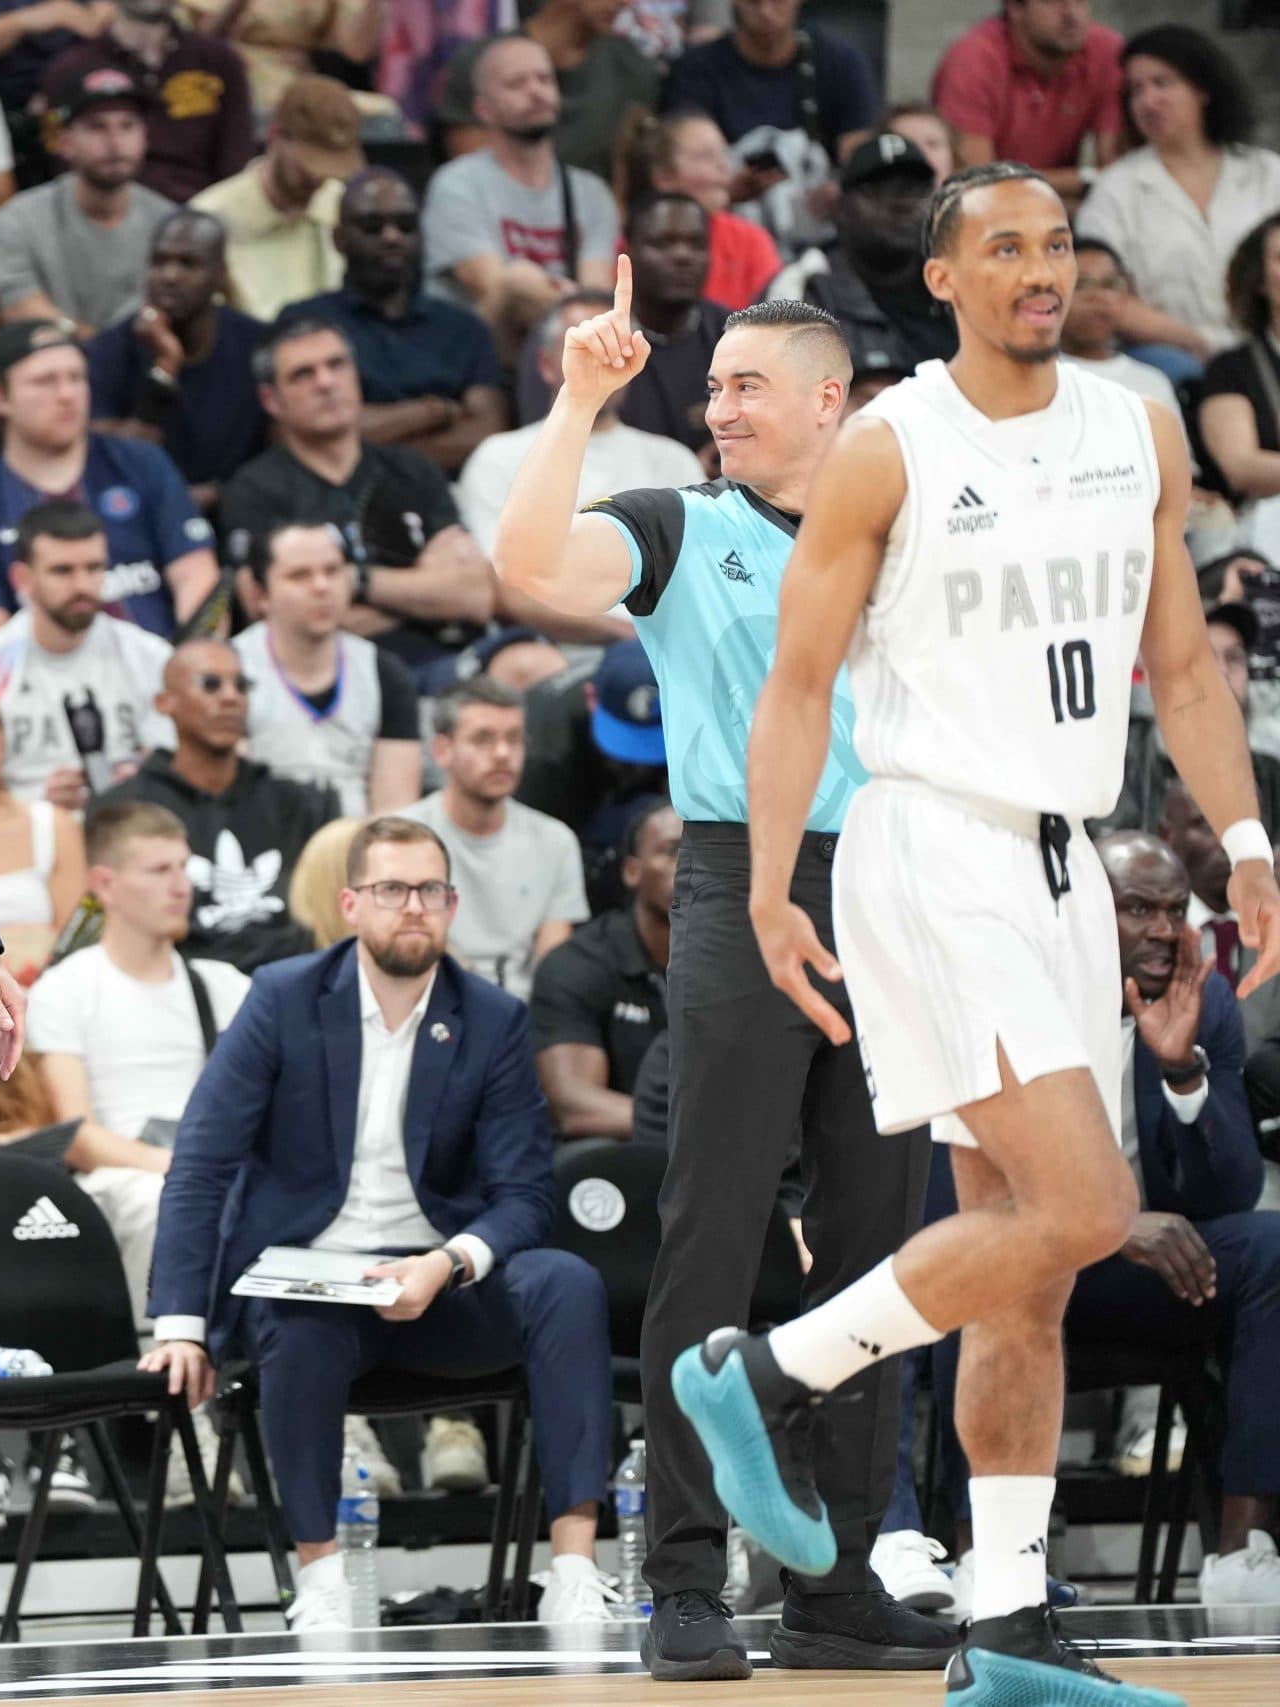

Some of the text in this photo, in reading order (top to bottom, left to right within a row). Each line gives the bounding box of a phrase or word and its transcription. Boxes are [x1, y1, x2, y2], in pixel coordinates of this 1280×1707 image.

[718, 561, 756, 587] PEAK
[943, 549, 1147, 638] PARIS
[1047, 638, 1096, 724] 10
[12, 1222, 80, 1241] adidas
